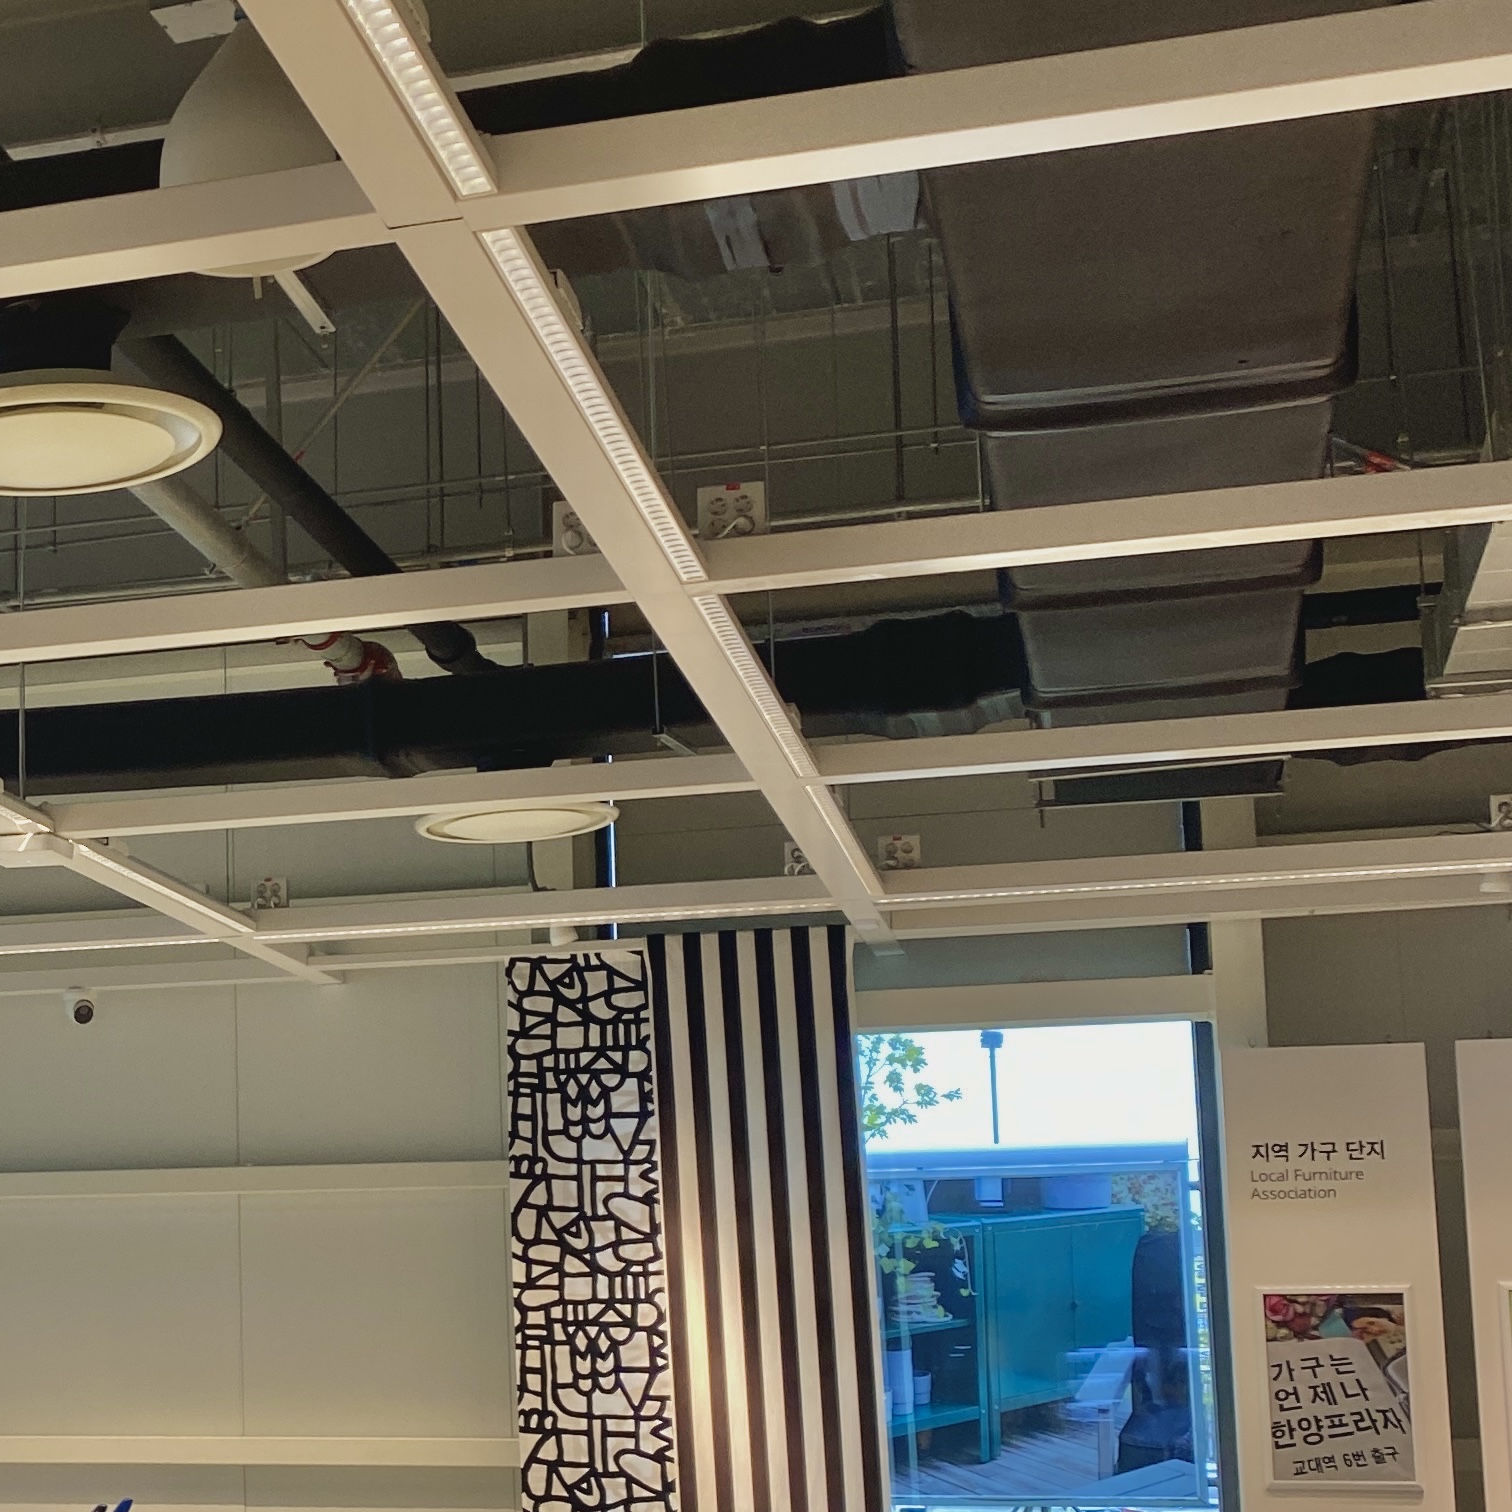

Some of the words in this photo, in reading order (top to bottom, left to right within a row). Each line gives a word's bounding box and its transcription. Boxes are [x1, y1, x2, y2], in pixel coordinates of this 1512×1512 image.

[1251, 1142, 1289, 1162] 지역
[1297, 1141, 1338, 1161] 가구
[1346, 1139, 1385, 1160] 단지
[1250, 1168, 1288, 1182] Local
[1294, 1167, 1364, 1181] Furniture
[1251, 1185, 1337, 1200] Association
[1270, 1354, 1355, 1382] 가구는
[1274, 1378, 1369, 1412] 언제나
[1271, 1408, 1407, 1450] 한양프라자
[1292, 1454, 1338, 1476] 교대역
[1342, 1450, 1368, 1467] 6번
[1370, 1446, 1400, 1465] 출구
